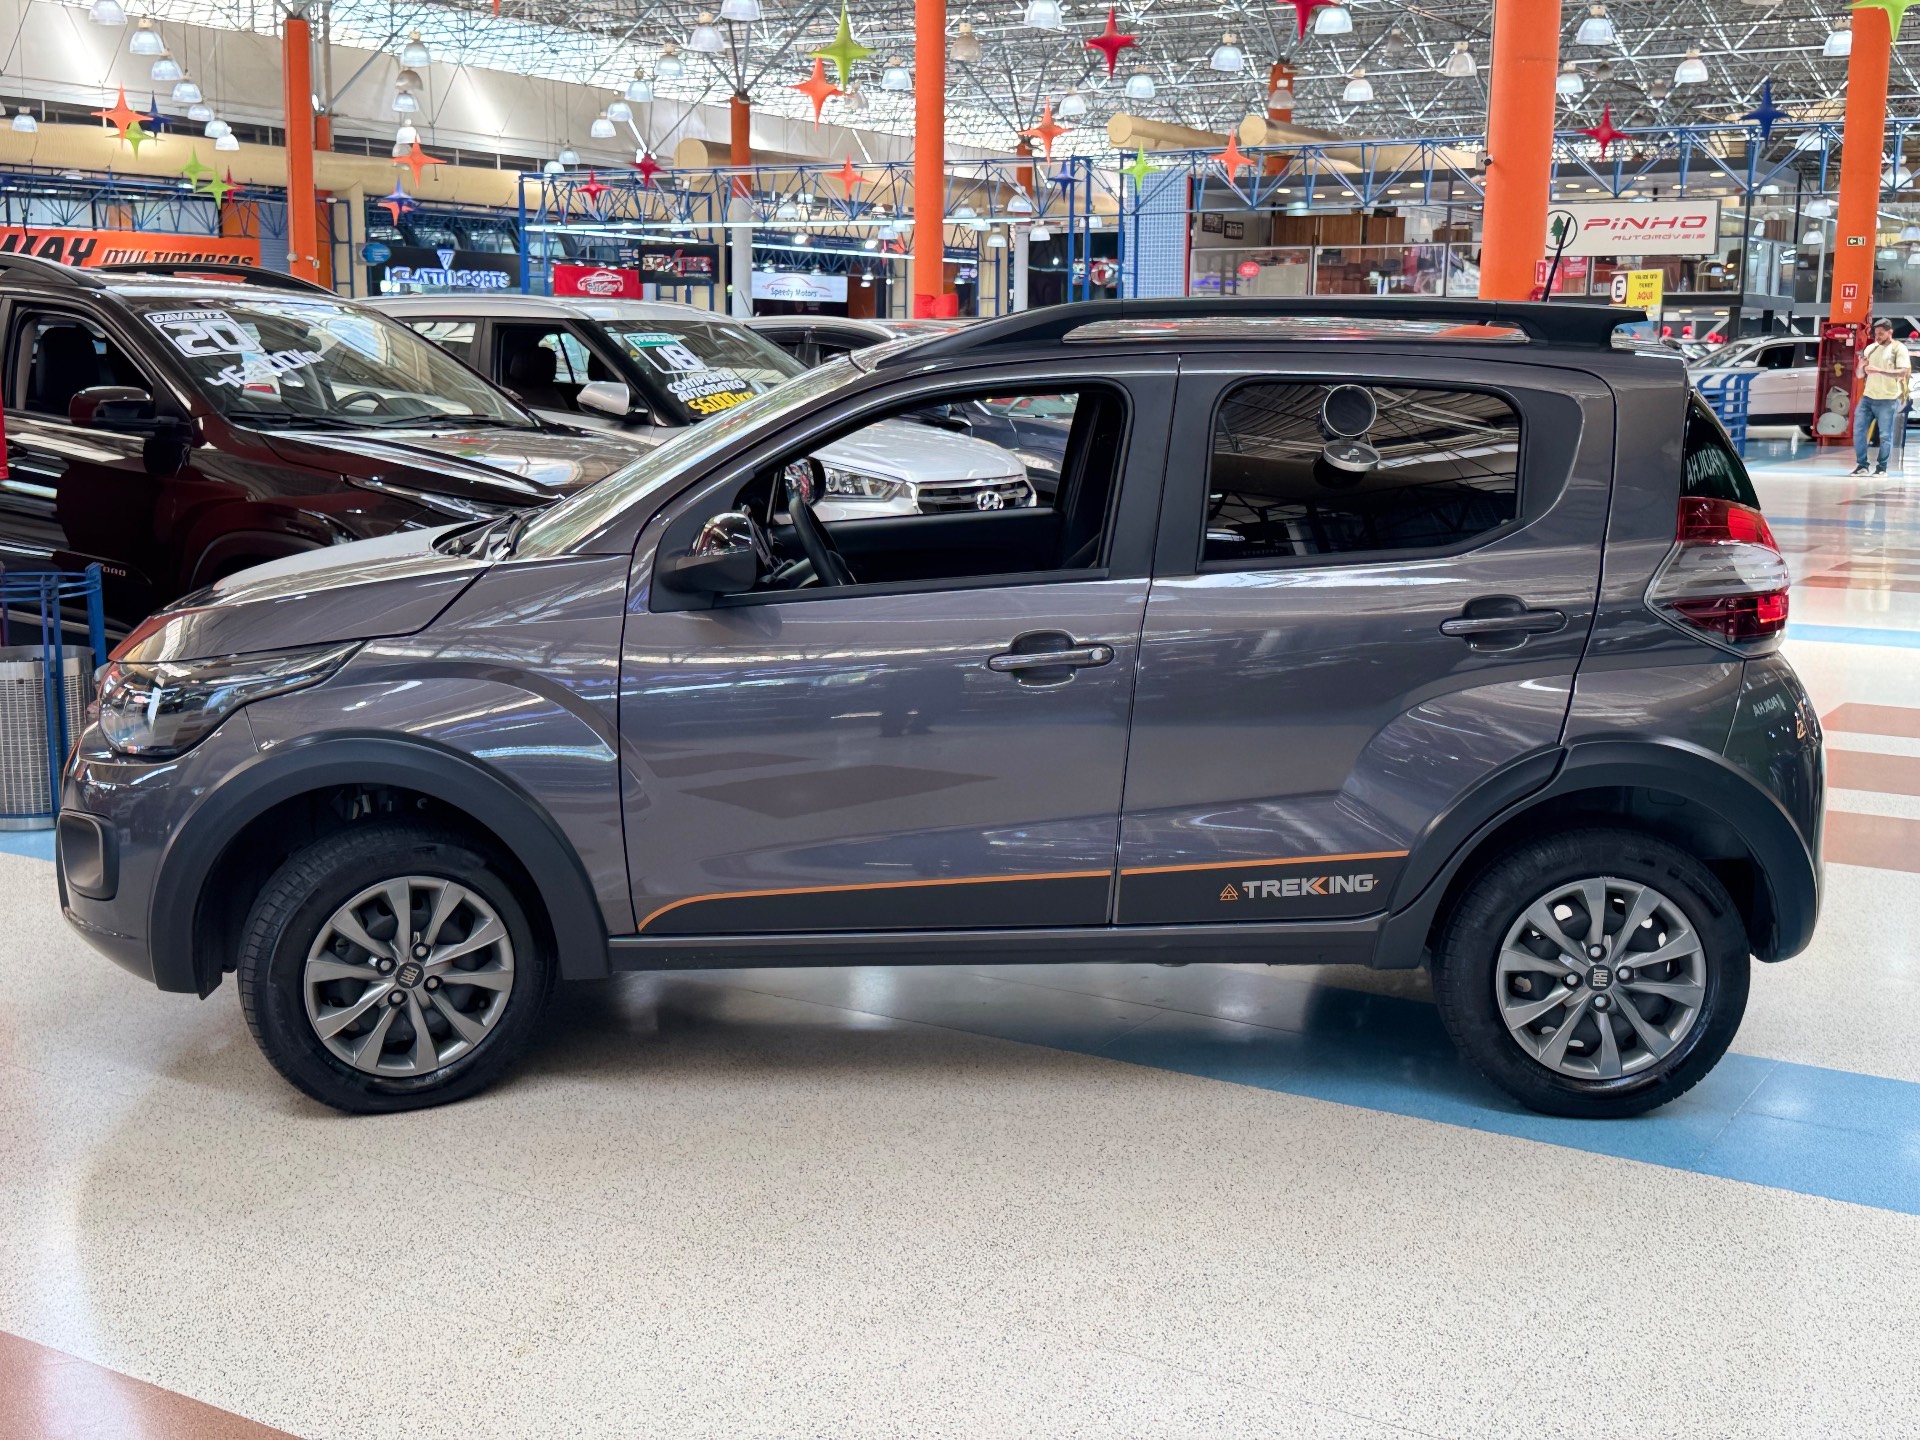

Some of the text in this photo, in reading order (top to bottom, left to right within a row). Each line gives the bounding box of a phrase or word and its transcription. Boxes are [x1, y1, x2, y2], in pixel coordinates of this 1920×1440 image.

[770, 287, 793, 298] Speedy
[796, 289, 818, 297] Motors
[1615, 280, 1624, 298] E
[1845, 287, 1854, 296] H
[163, 321, 259, 353] 20
[656, 345, 706, 370] 18
[1242, 873, 1379, 899] TREKKING
